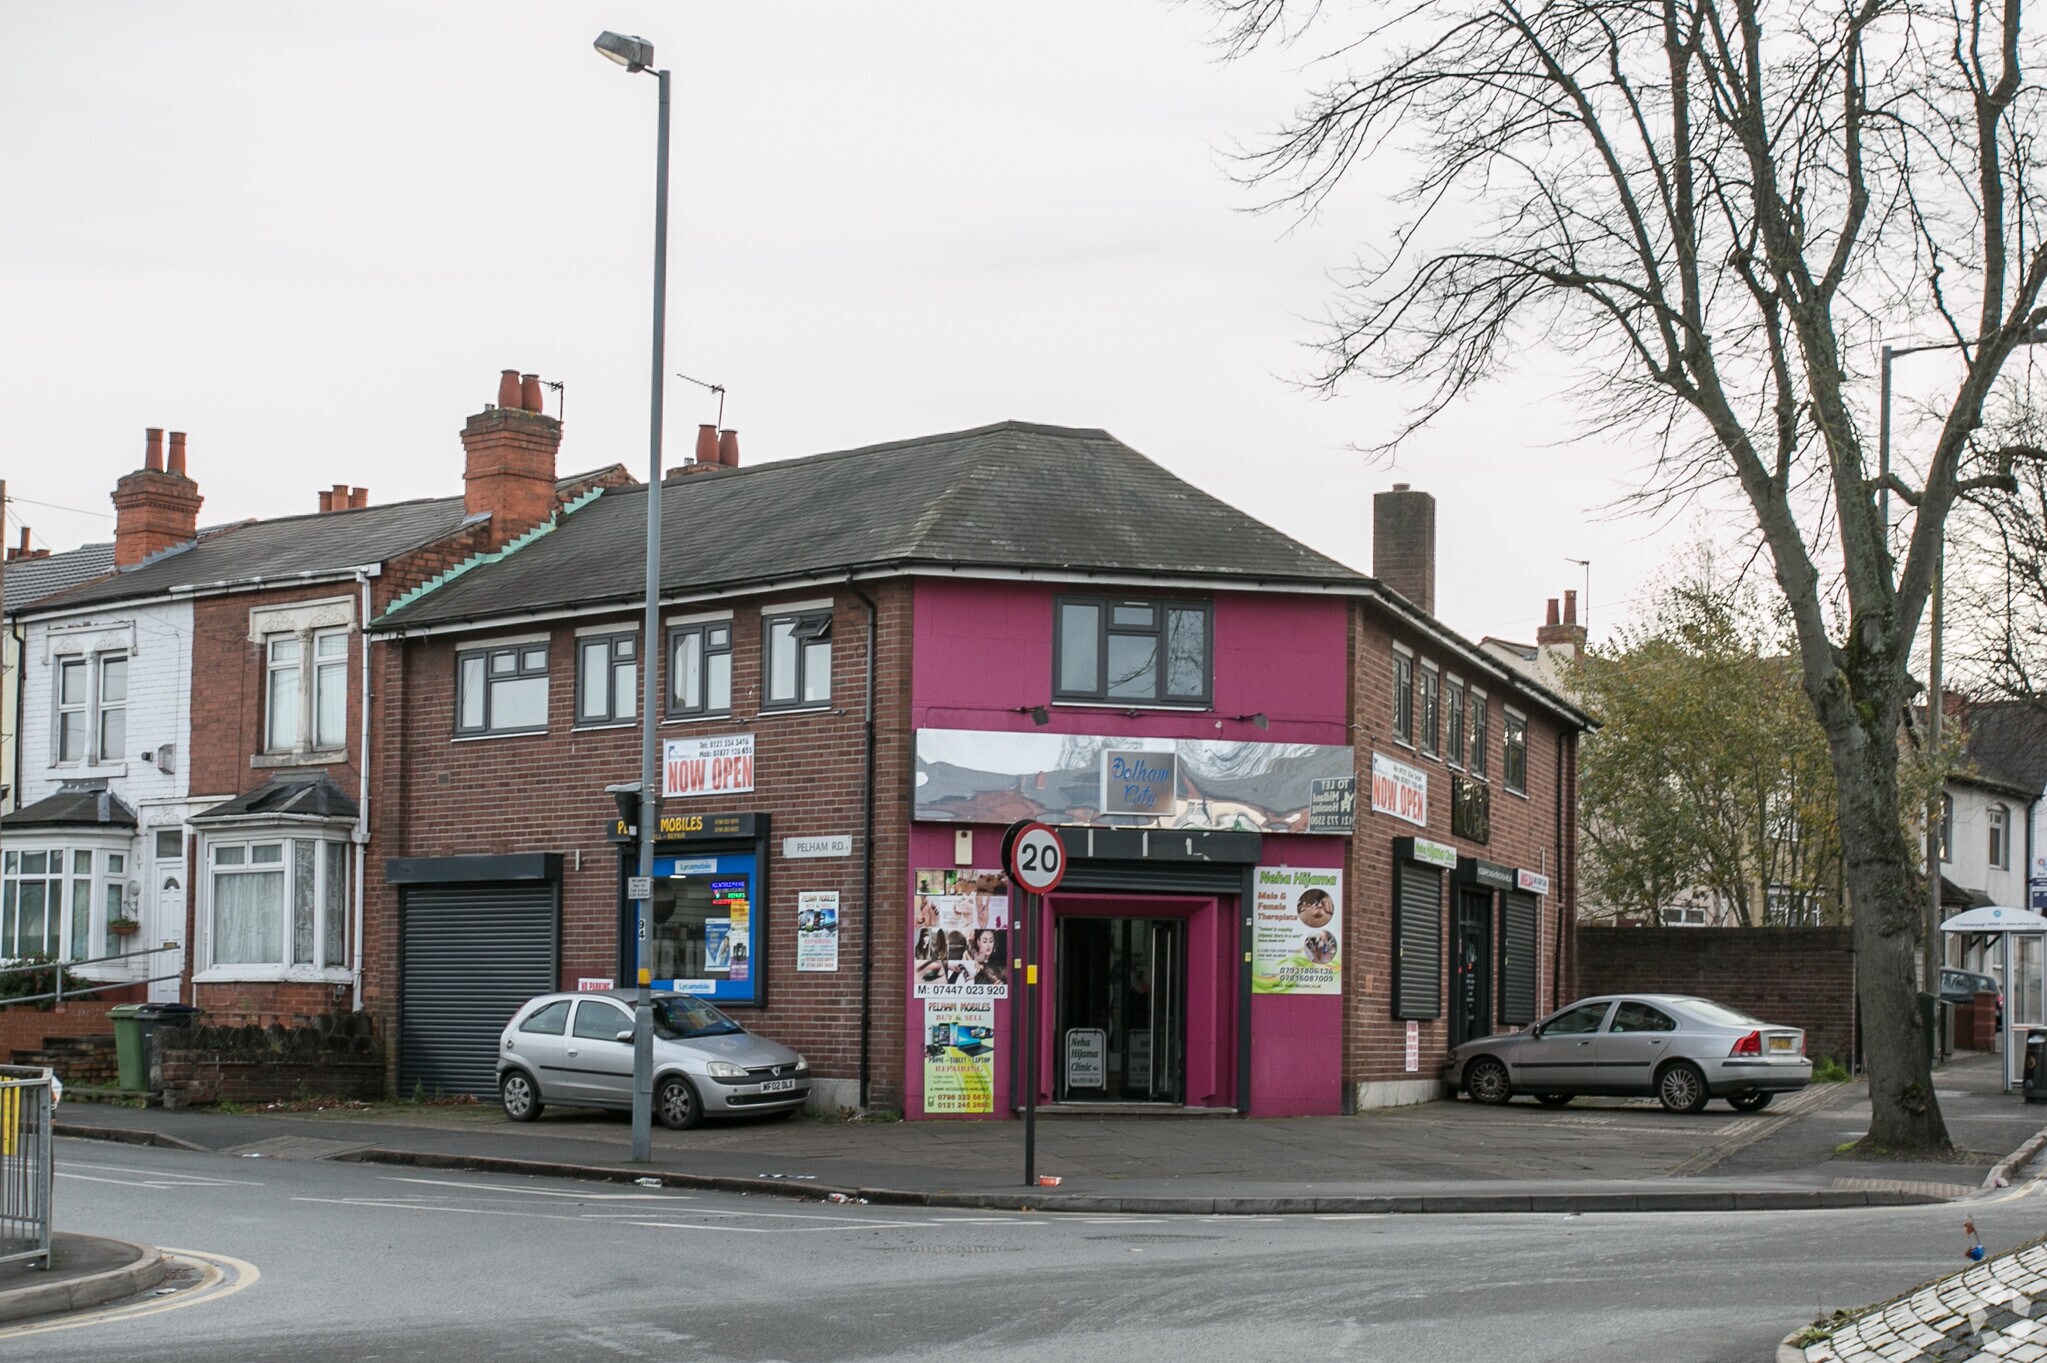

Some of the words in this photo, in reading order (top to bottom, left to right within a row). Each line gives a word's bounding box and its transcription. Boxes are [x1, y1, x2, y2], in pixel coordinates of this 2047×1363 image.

[669, 759, 706, 793] NOW
[712, 755, 752, 790] OPEN
[1373, 774, 1397, 811] NOW
[1400, 784, 1423, 821] OPEN
[660, 816, 703, 833] MOBILES
[797, 842, 828, 852] PELHAM
[1022, 843, 1058, 873] 20
[680, 862, 711, 871] Lycamobile
[1259, 871, 1292, 884] Neha
[1293, 872, 1337, 888] Hijama
[679, 982, 709, 990] Lycamobile
[918, 985, 930, 994] M:
[933, 986, 963, 994] 07447
[966, 986, 984, 995] 023
[987, 986, 1005, 995] 920
[928, 1002, 957, 1012] PELHAM
[960, 1002, 991, 1012] MOBILES
[1071, 1037, 1090, 1046] Neha
[1071, 1049, 1098, 1060] Hijama
[1071, 1062, 1092, 1071] Clinic
